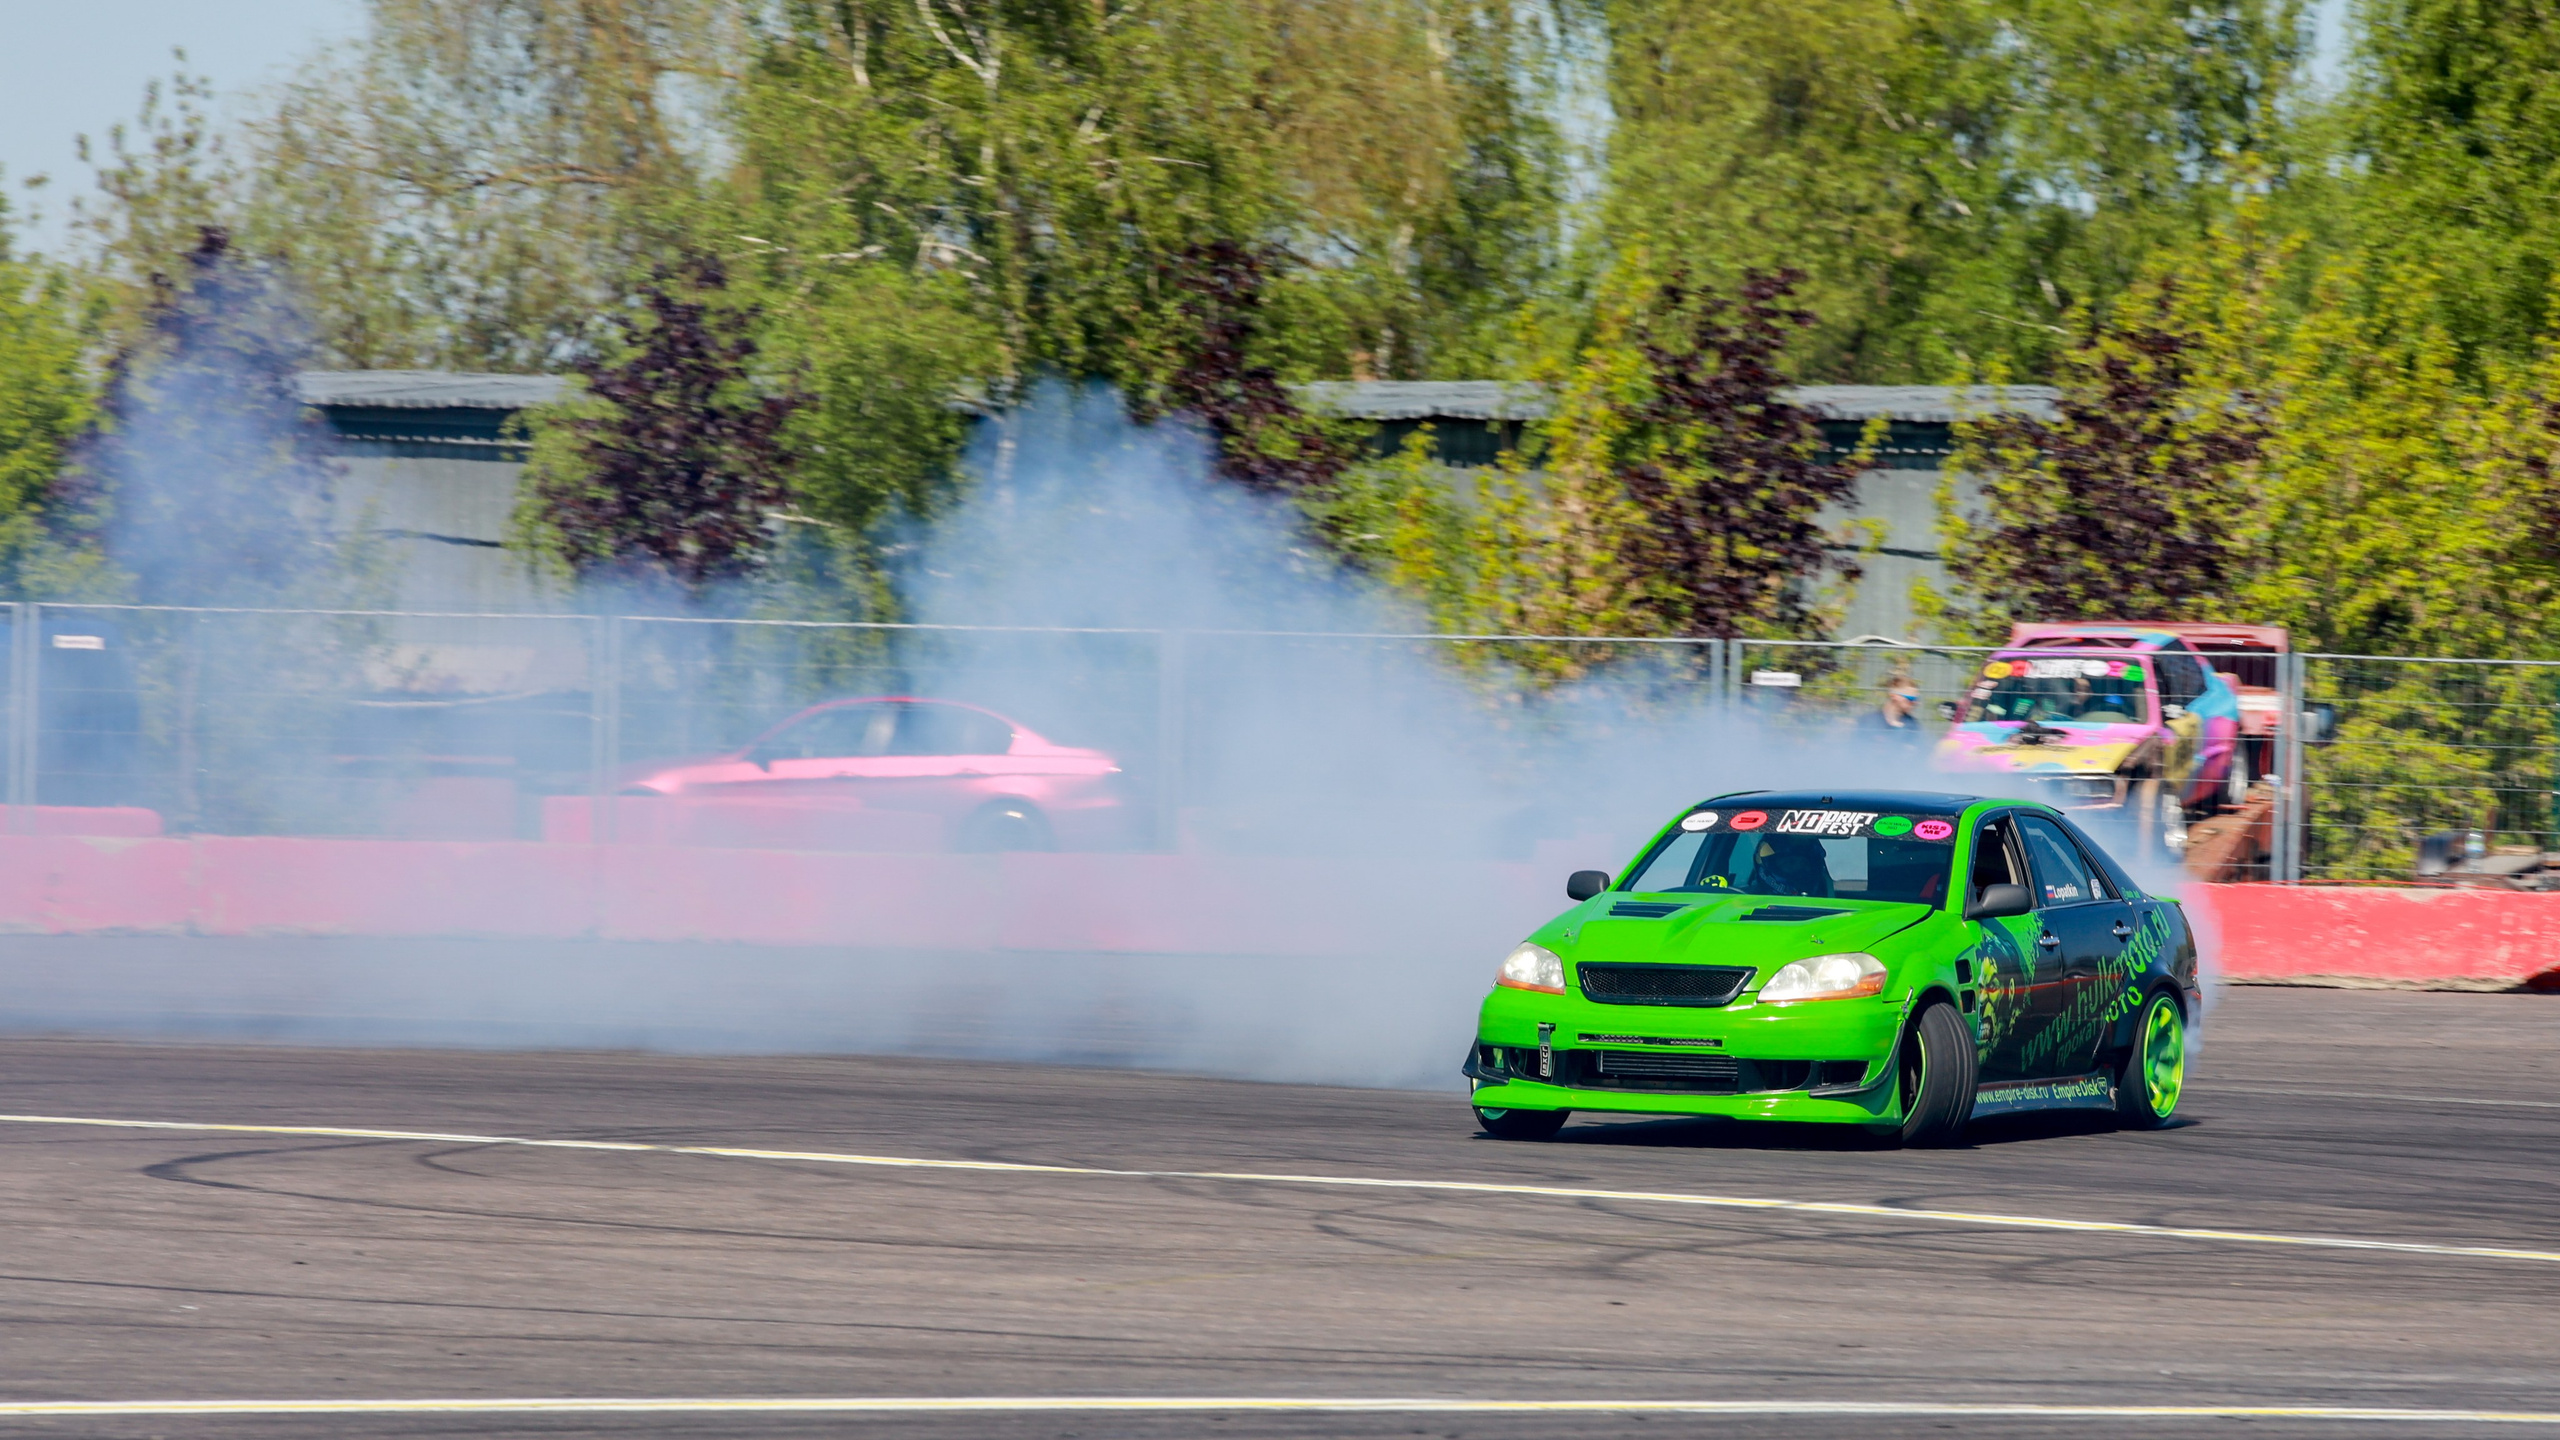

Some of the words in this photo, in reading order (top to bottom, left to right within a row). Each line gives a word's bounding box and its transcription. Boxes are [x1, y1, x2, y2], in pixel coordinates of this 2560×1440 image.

[1824, 811, 1878, 825] DRIFT
[1818, 822, 1864, 835] FEST
[2053, 883, 2079, 902] Lopatkin
[1976, 1084, 2049, 1105] www.empire-disk.ru
